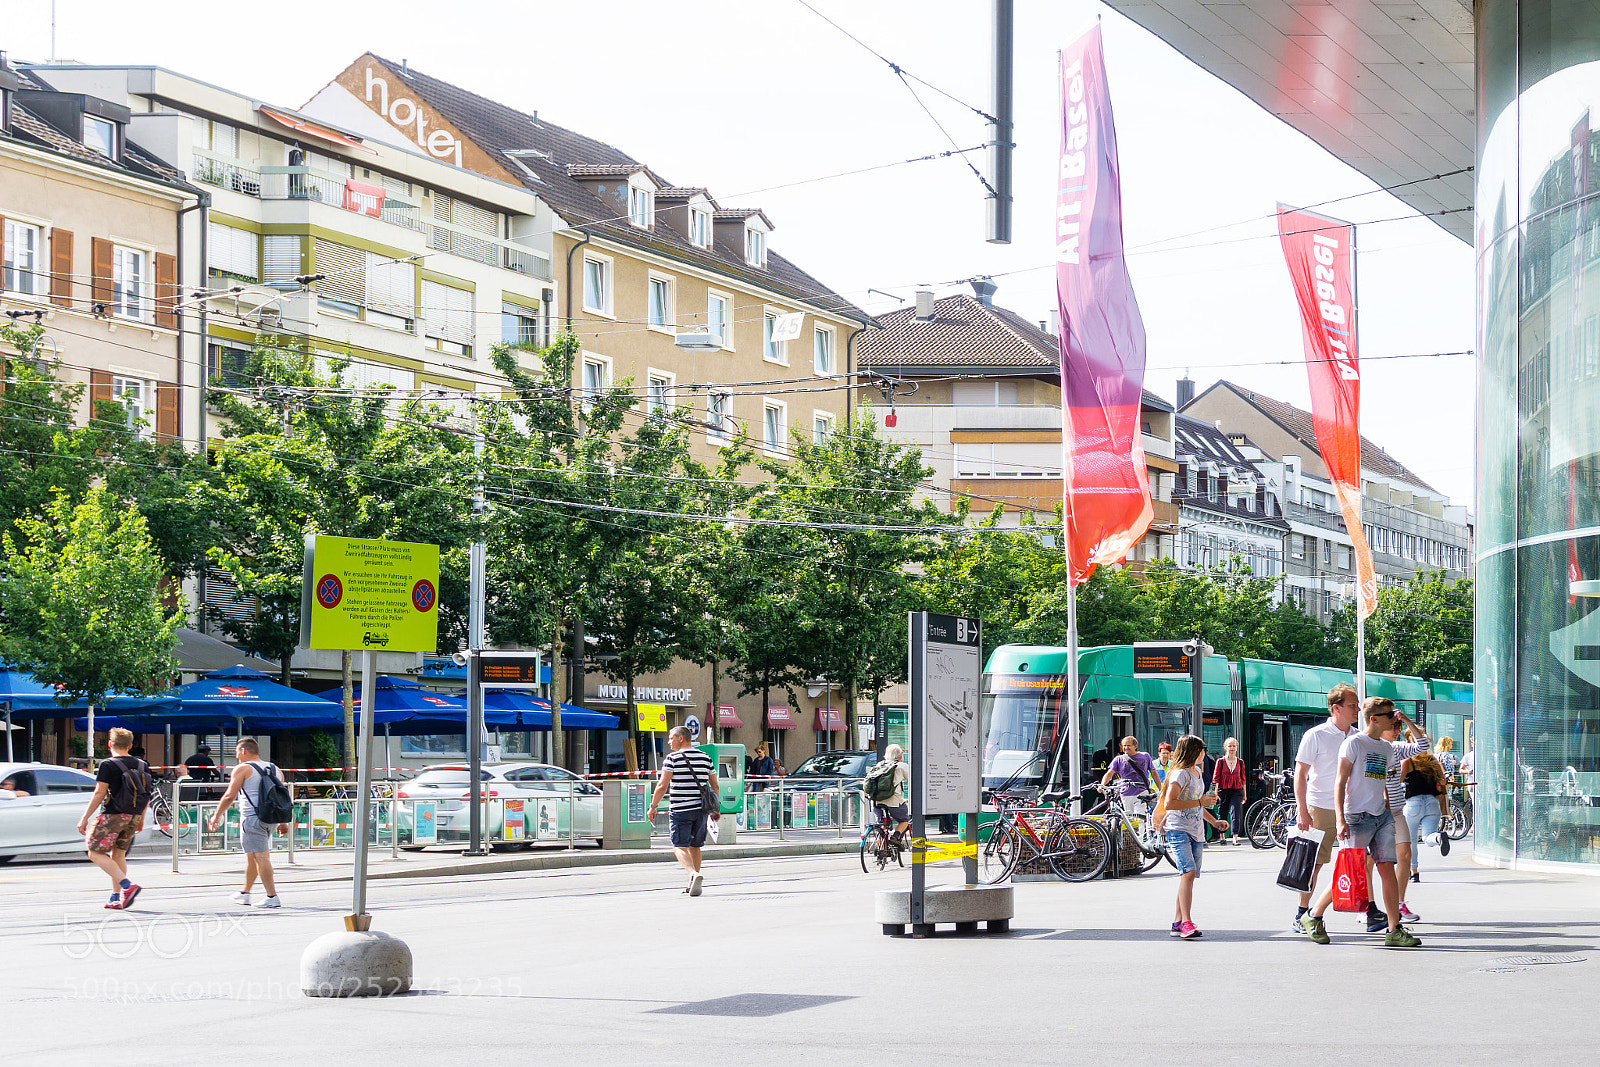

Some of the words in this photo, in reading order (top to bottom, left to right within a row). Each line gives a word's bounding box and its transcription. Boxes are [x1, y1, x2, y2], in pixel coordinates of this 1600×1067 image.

[366, 68, 462, 168] hotel
[1061, 59, 1088, 180] Basel
[1056, 200, 1082, 265] Art
[777, 317, 799, 335] 45
[958, 622, 964, 639] 3
[598, 685, 692, 701] MÜNHNERHOF
